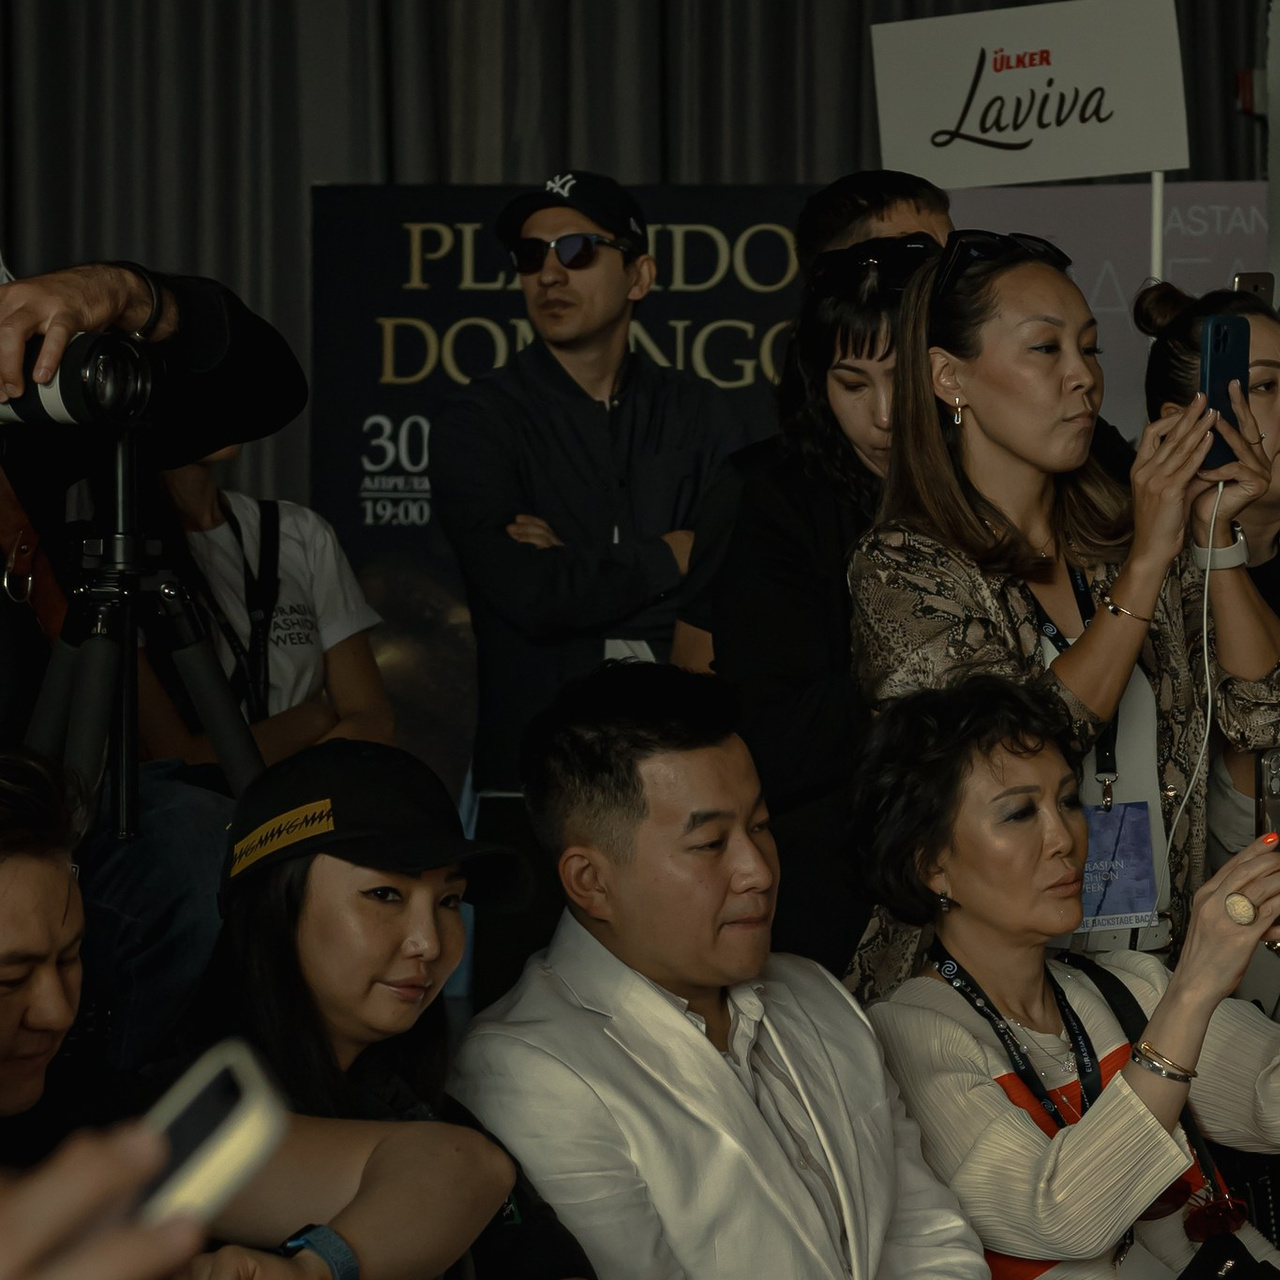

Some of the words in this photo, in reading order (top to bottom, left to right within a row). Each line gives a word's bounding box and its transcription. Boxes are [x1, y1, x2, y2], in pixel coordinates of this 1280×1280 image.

[993, 48, 1051, 73] ÜLKER
[930, 47, 1113, 151] Laviva
[400, 222, 801, 293] PLIDO
[360, 414, 432, 474] 30
[361, 499, 431, 527] 19:00
[270, 632, 314, 646] WEEK
[1084, 859, 1125, 872] RASIAN
[1084, 870, 1119, 883] SHION
[1082, 881, 1105, 893] EEK
